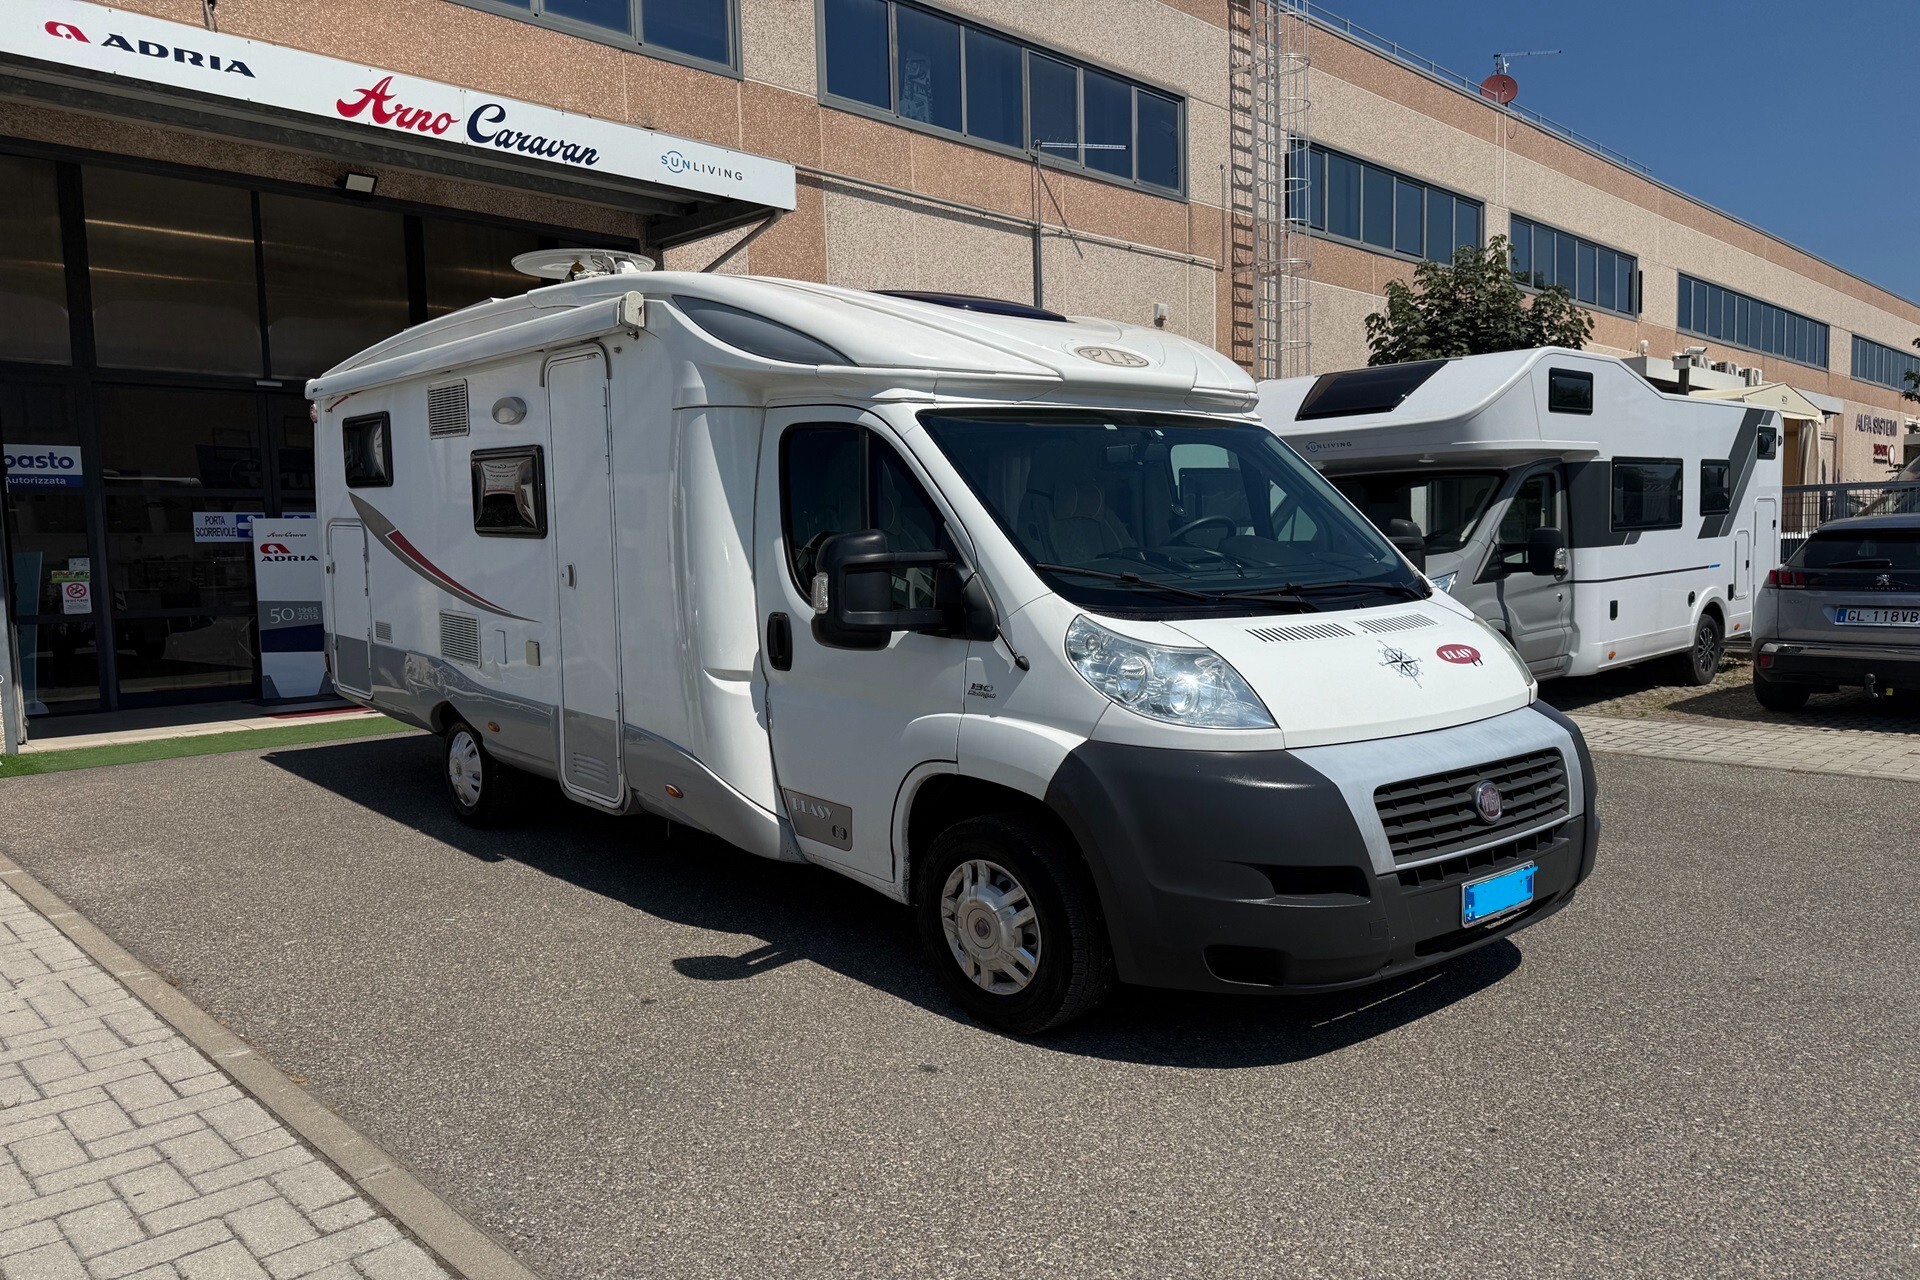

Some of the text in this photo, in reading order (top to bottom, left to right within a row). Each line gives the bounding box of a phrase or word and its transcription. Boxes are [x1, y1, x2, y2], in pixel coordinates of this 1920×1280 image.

[101, 33, 256, 78] ADRIA
[336, 75, 600, 166] Arno Caravan
[661, 151, 743, 181] SUNLIVING
[1087, 349, 1144, 365] PLA
[205, 515, 226, 525] PORTA
[195, 527, 236, 537] SCORREVOLE
[270, 607, 295, 624] 50
[1848, 610, 1920, 623] GL 118VB
